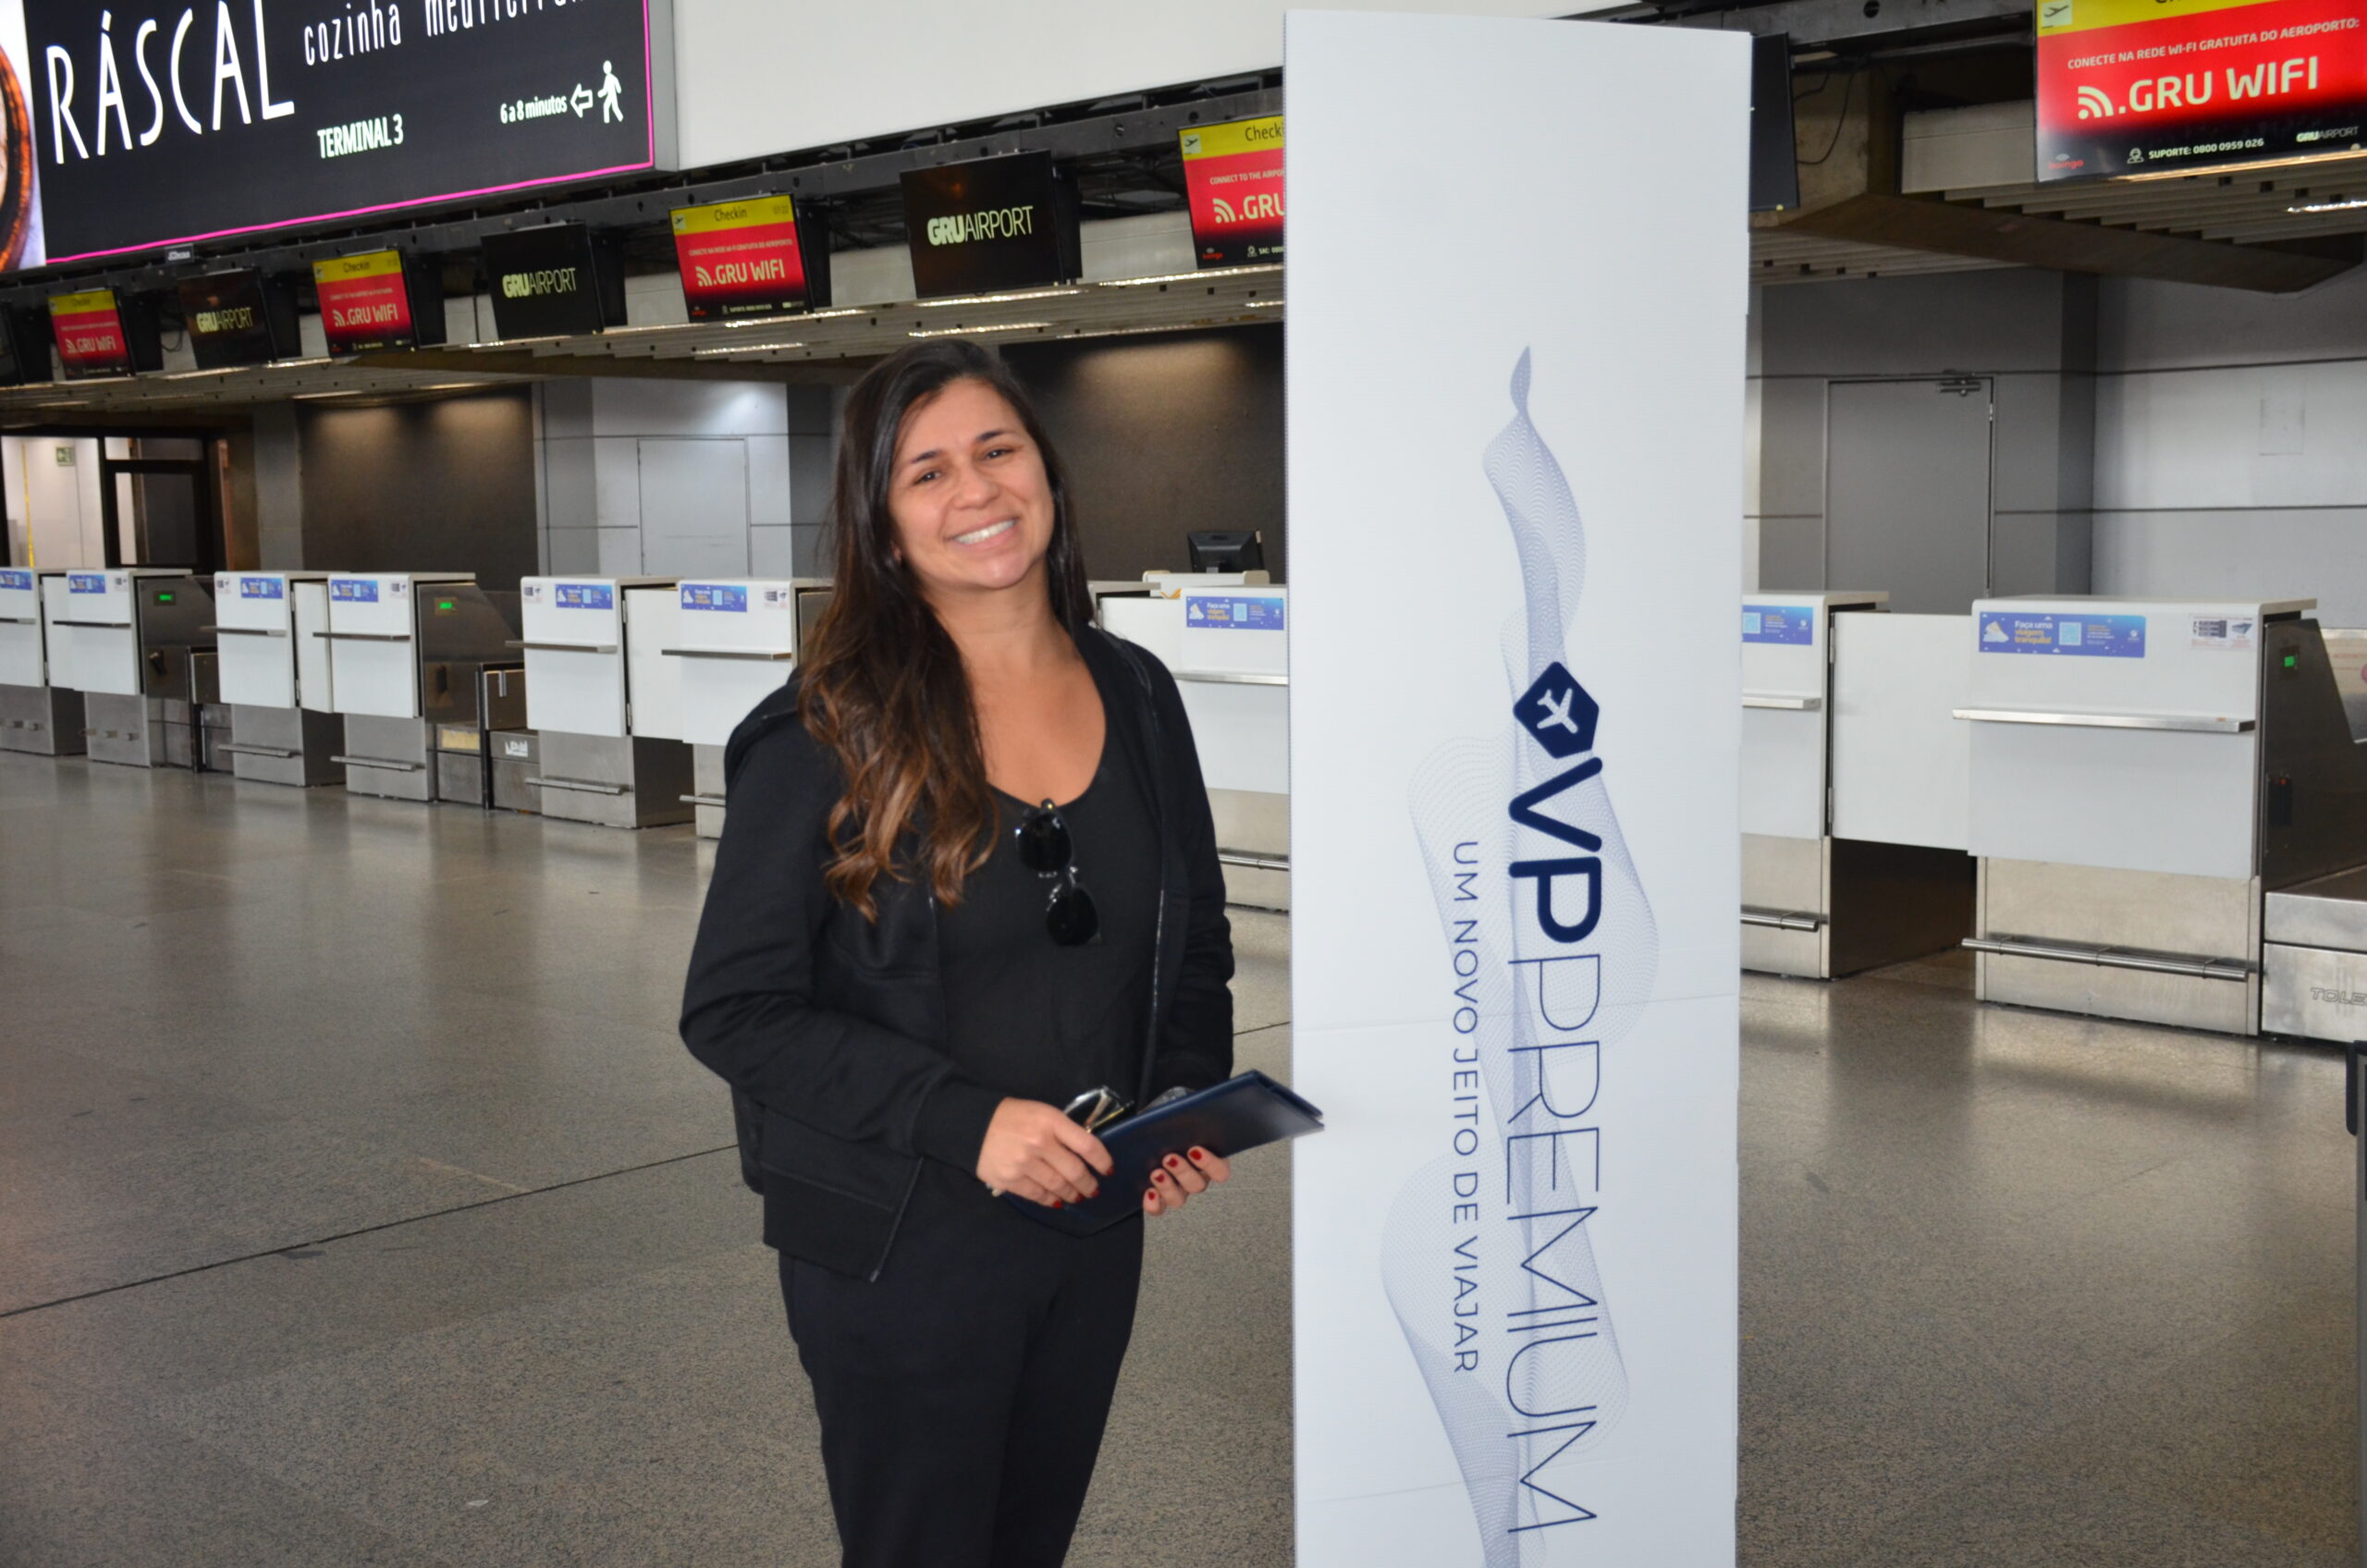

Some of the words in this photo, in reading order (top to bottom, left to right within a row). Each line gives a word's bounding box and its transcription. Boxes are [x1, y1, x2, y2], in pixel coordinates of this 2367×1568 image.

[304, 0, 401, 66] cozinha
[2067, 53, 2116, 69] CONECTE
[2118, 51, 2134, 62] NA
[2137, 46, 2165, 59] REDE
[2168, 41, 2197, 55] WI-FI
[2199, 32, 2258, 51] GRATUITA
[2260, 30, 2278, 43] DO
[2280, 18, 2361, 39] AEROPORTO:
[46, 0, 295, 164] RÁSCAL
[2226, 55, 2318, 100] WIFI
[500, 103, 508, 124] 6
[509, 105, 516, 122] a
[517, 100, 524, 120] 8
[525, 95, 568, 119] minutos
[316, 116, 392, 159] TERMINAL
[392, 113, 404, 144] 3
[2148, 146, 2191, 159] SUPORTE:
[2193, 143, 2217, 154] 0800
[2218, 141, 2244, 151] 0959
[2245, 138, 2264, 148] 026
[1209, 174, 1238, 185] CONNECT
[1239, 173, 1248, 181] TO
[1249, 170, 1261, 180] THE
[1262, 167, 1284, 178] AIRPO
[714, 206, 747, 222] Checkin
[750, 258, 786, 281] WIFI
[373, 303, 399, 322] WIFI
[1453, 841, 1478, 901] UM
[1453, 919, 1478, 1034] NOVO
[2310, 986, 2367, 1007] TOLE
[1453, 1047, 1478, 1156] JEITO
[1453, 1172, 1478, 1223] DE
[1453, 1235, 1478, 1373] VIAJAR
